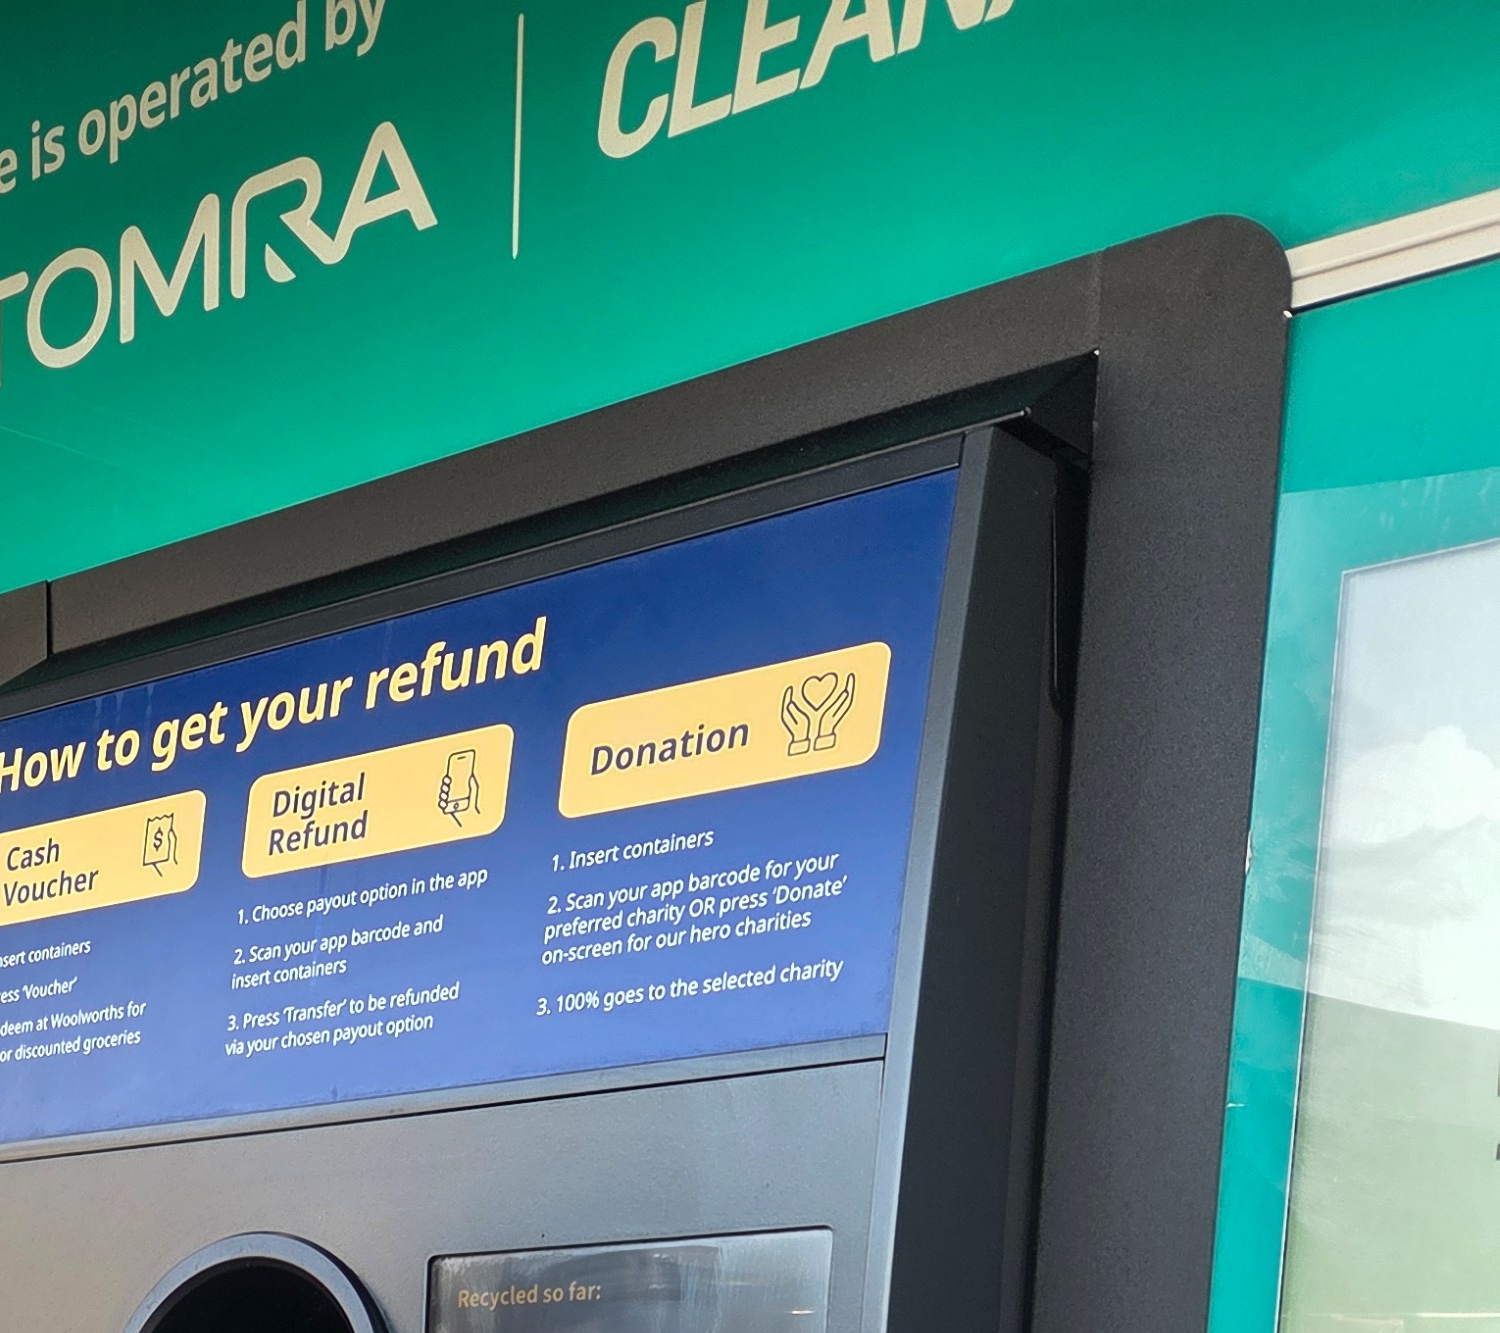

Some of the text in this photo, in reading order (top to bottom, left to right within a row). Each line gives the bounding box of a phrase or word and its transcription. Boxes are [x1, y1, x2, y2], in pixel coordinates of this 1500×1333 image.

[31, 120, 65, 180] is
[78, 0, 306, 164] operated
[325, 0, 385, 55] by
[96, 728, 139, 772] to
[151, 702, 226, 772] get
[236, 676, 352, 752] your
[366, 618, 548, 709] refund
[591, 723, 749, 775] Donation
[272, 772, 365, 819] Digital
[7, 838, 59, 871] Cash
[269, 810, 368, 855] Refund
[552, 831, 714, 872] 1. Insert containers
[3, 869, 99, 906] Voucher
[238, 869, 488, 924] 1. Choose payout option in the app
[548, 853, 839, 914] 2. Scan your app barcode for your
[234, 914, 443, 965] 2. Scan your app barcode and
[542, 911, 811, 965] on-screen for our hero charities
[544, 911, 622, 944] preferred
[627, 903, 685, 929] charity
[689, 899, 714, 918] OR
[719, 892, 767, 916] press
[28, 941, 91, 963] containers
[231, 958, 347, 990] insert containers
[228, 1016, 239, 1031] 3.
[243, 1009, 280, 1029] Press
[349, 999, 364, 1014] to
[368, 993, 387, 1010] be
[390, 981, 459, 1008] refunded
[536, 959, 843, 1016] 3. 100% goes to the selected charity
[36, 1017, 47, 1031] at
[51, 1004, 124, 1029] Woolworths
[127, 1001, 146, 1019] for
[225, 1014, 433, 1057] via your chosen payout option
[0, 1049, 12, 1062] or
[15, 1036, 81, 1061] discounted
[83, 1029, 141, 1053] groceries
[458, 1281, 601, 1311] Recycled so far:
